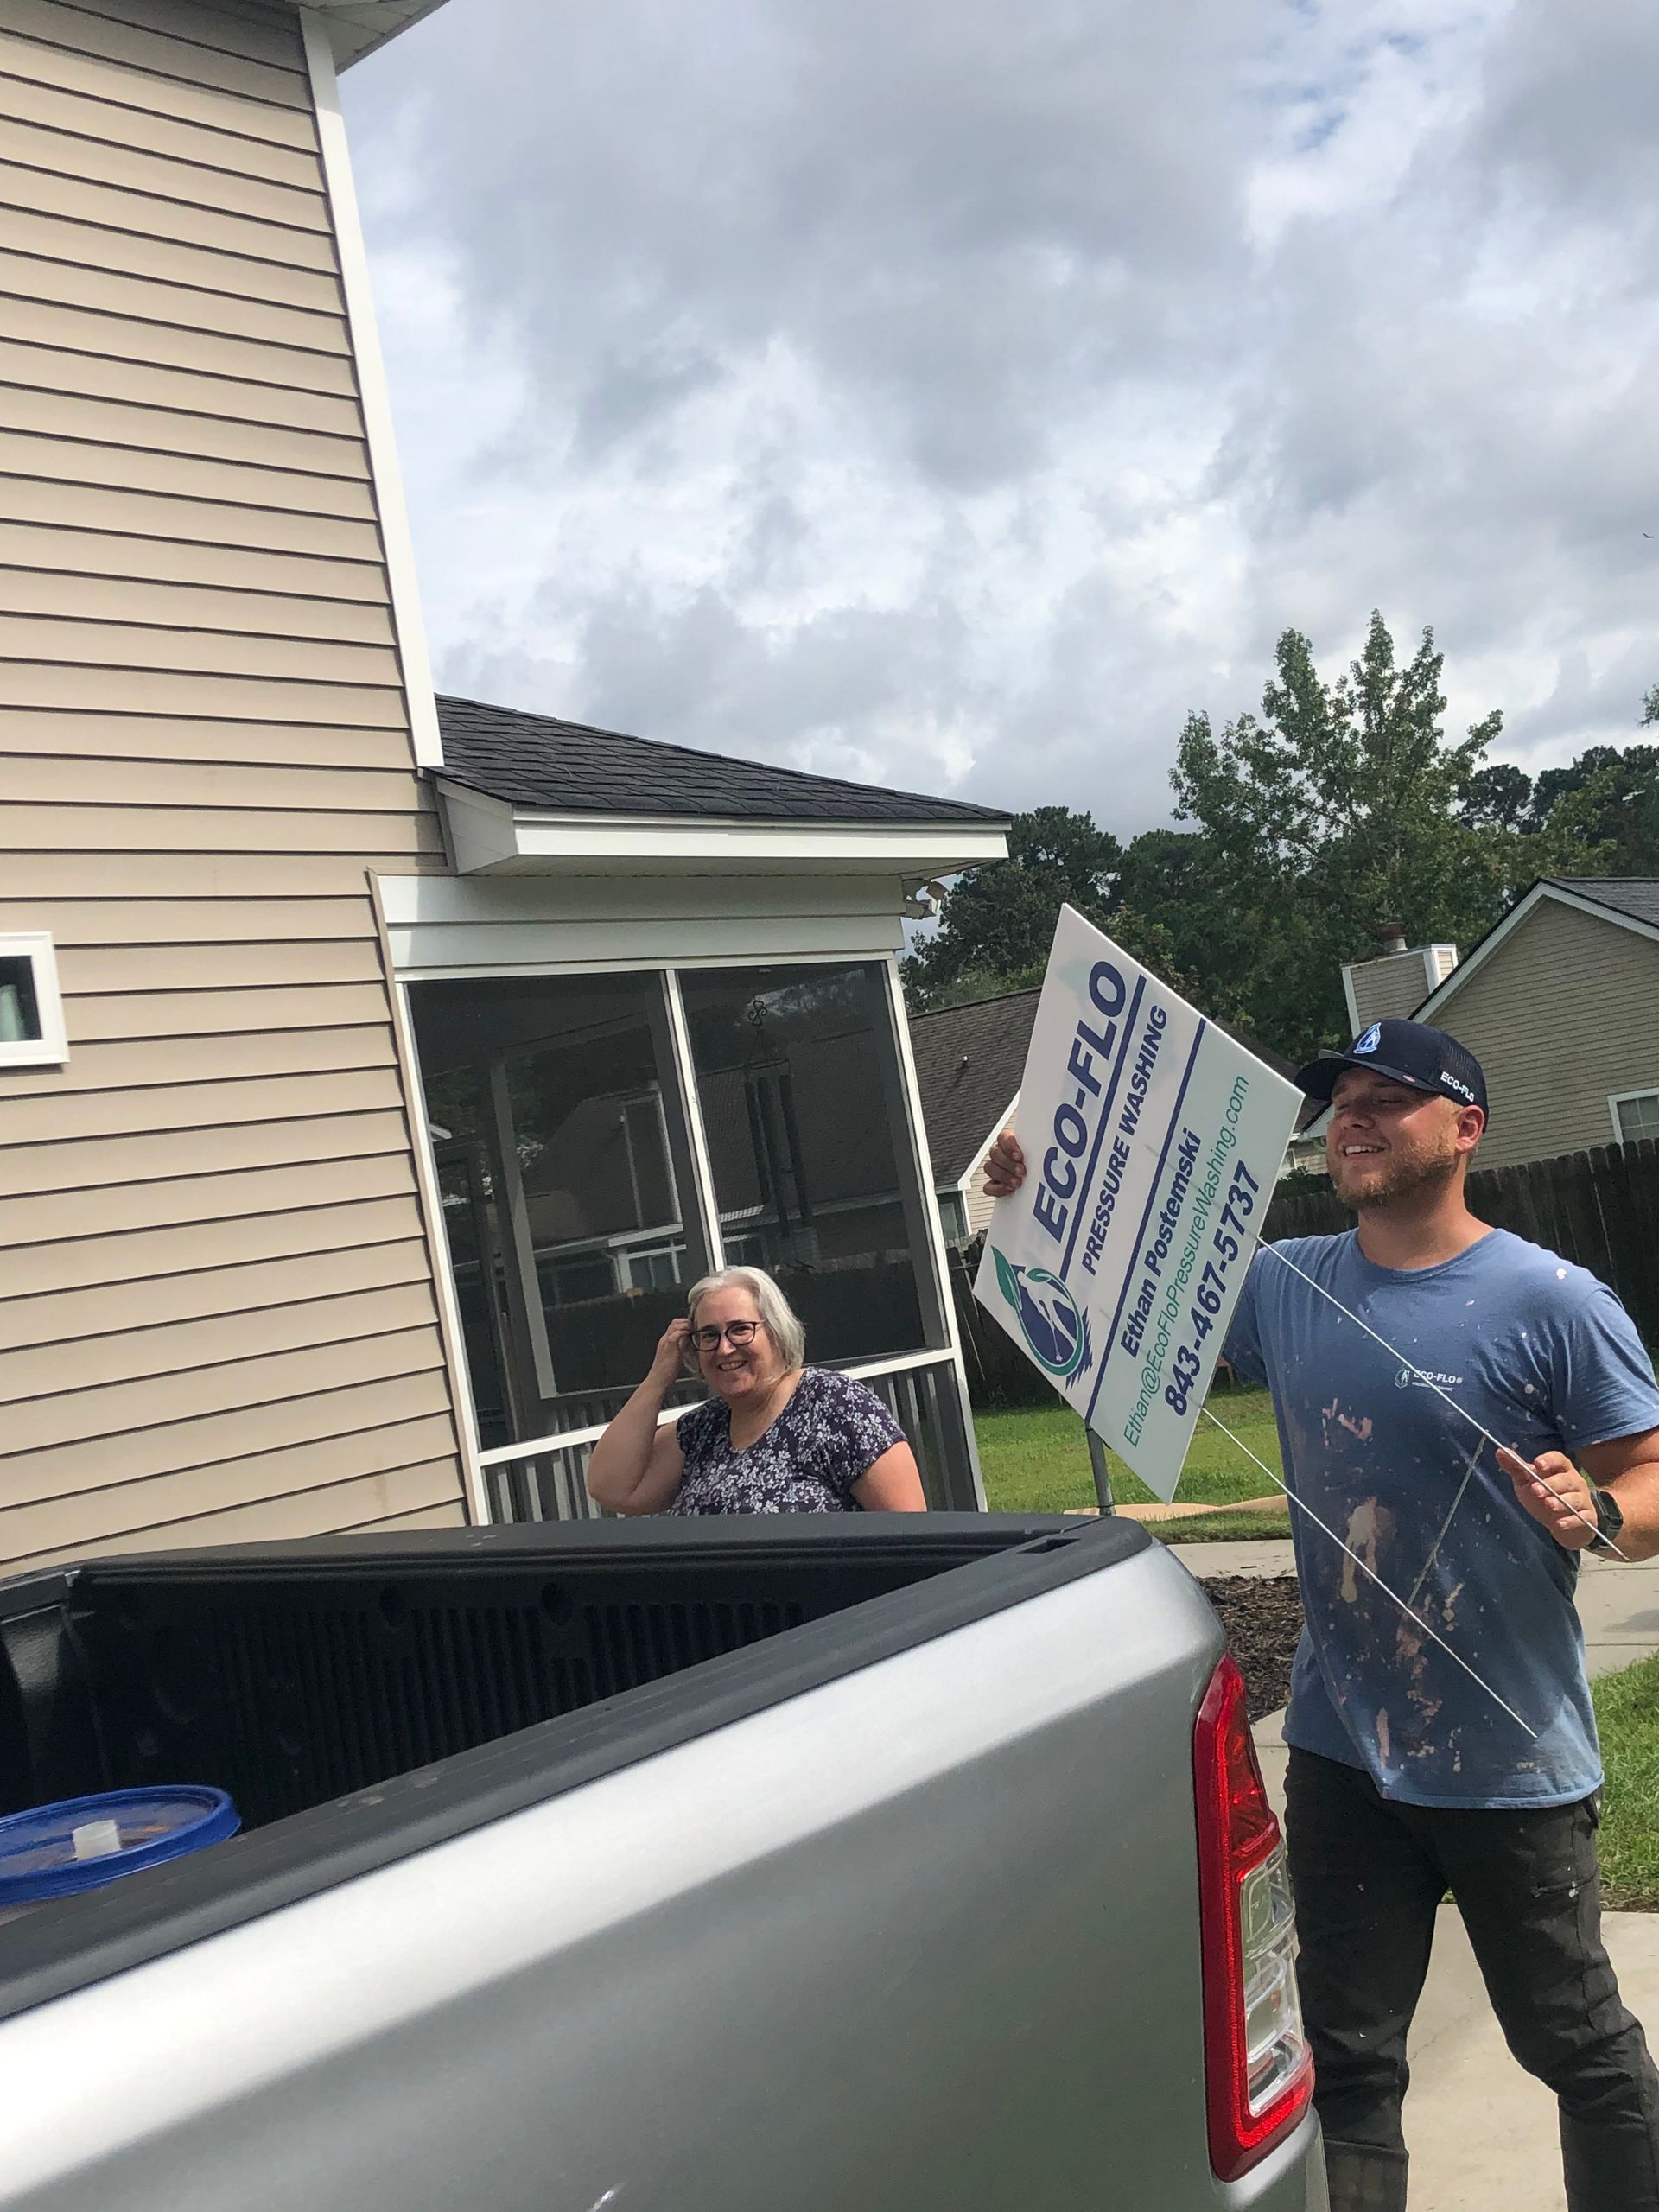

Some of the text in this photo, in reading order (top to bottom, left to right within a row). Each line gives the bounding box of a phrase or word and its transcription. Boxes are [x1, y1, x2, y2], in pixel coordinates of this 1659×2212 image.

[1033, 960, 1127, 1243] ECO-FLO
[1082, 1005, 1168, 1276] PRESSURE WASHING
[1440, 1071, 1474, 1102] ECO-FLO
[1121, 1126, 1201, 1359] Ethan Postemski
[1123, 1075, 1250, 1448] Ethan@EcoFloPressureWashing.com
[1165, 1160, 1262, 1417] 843-467-5737
